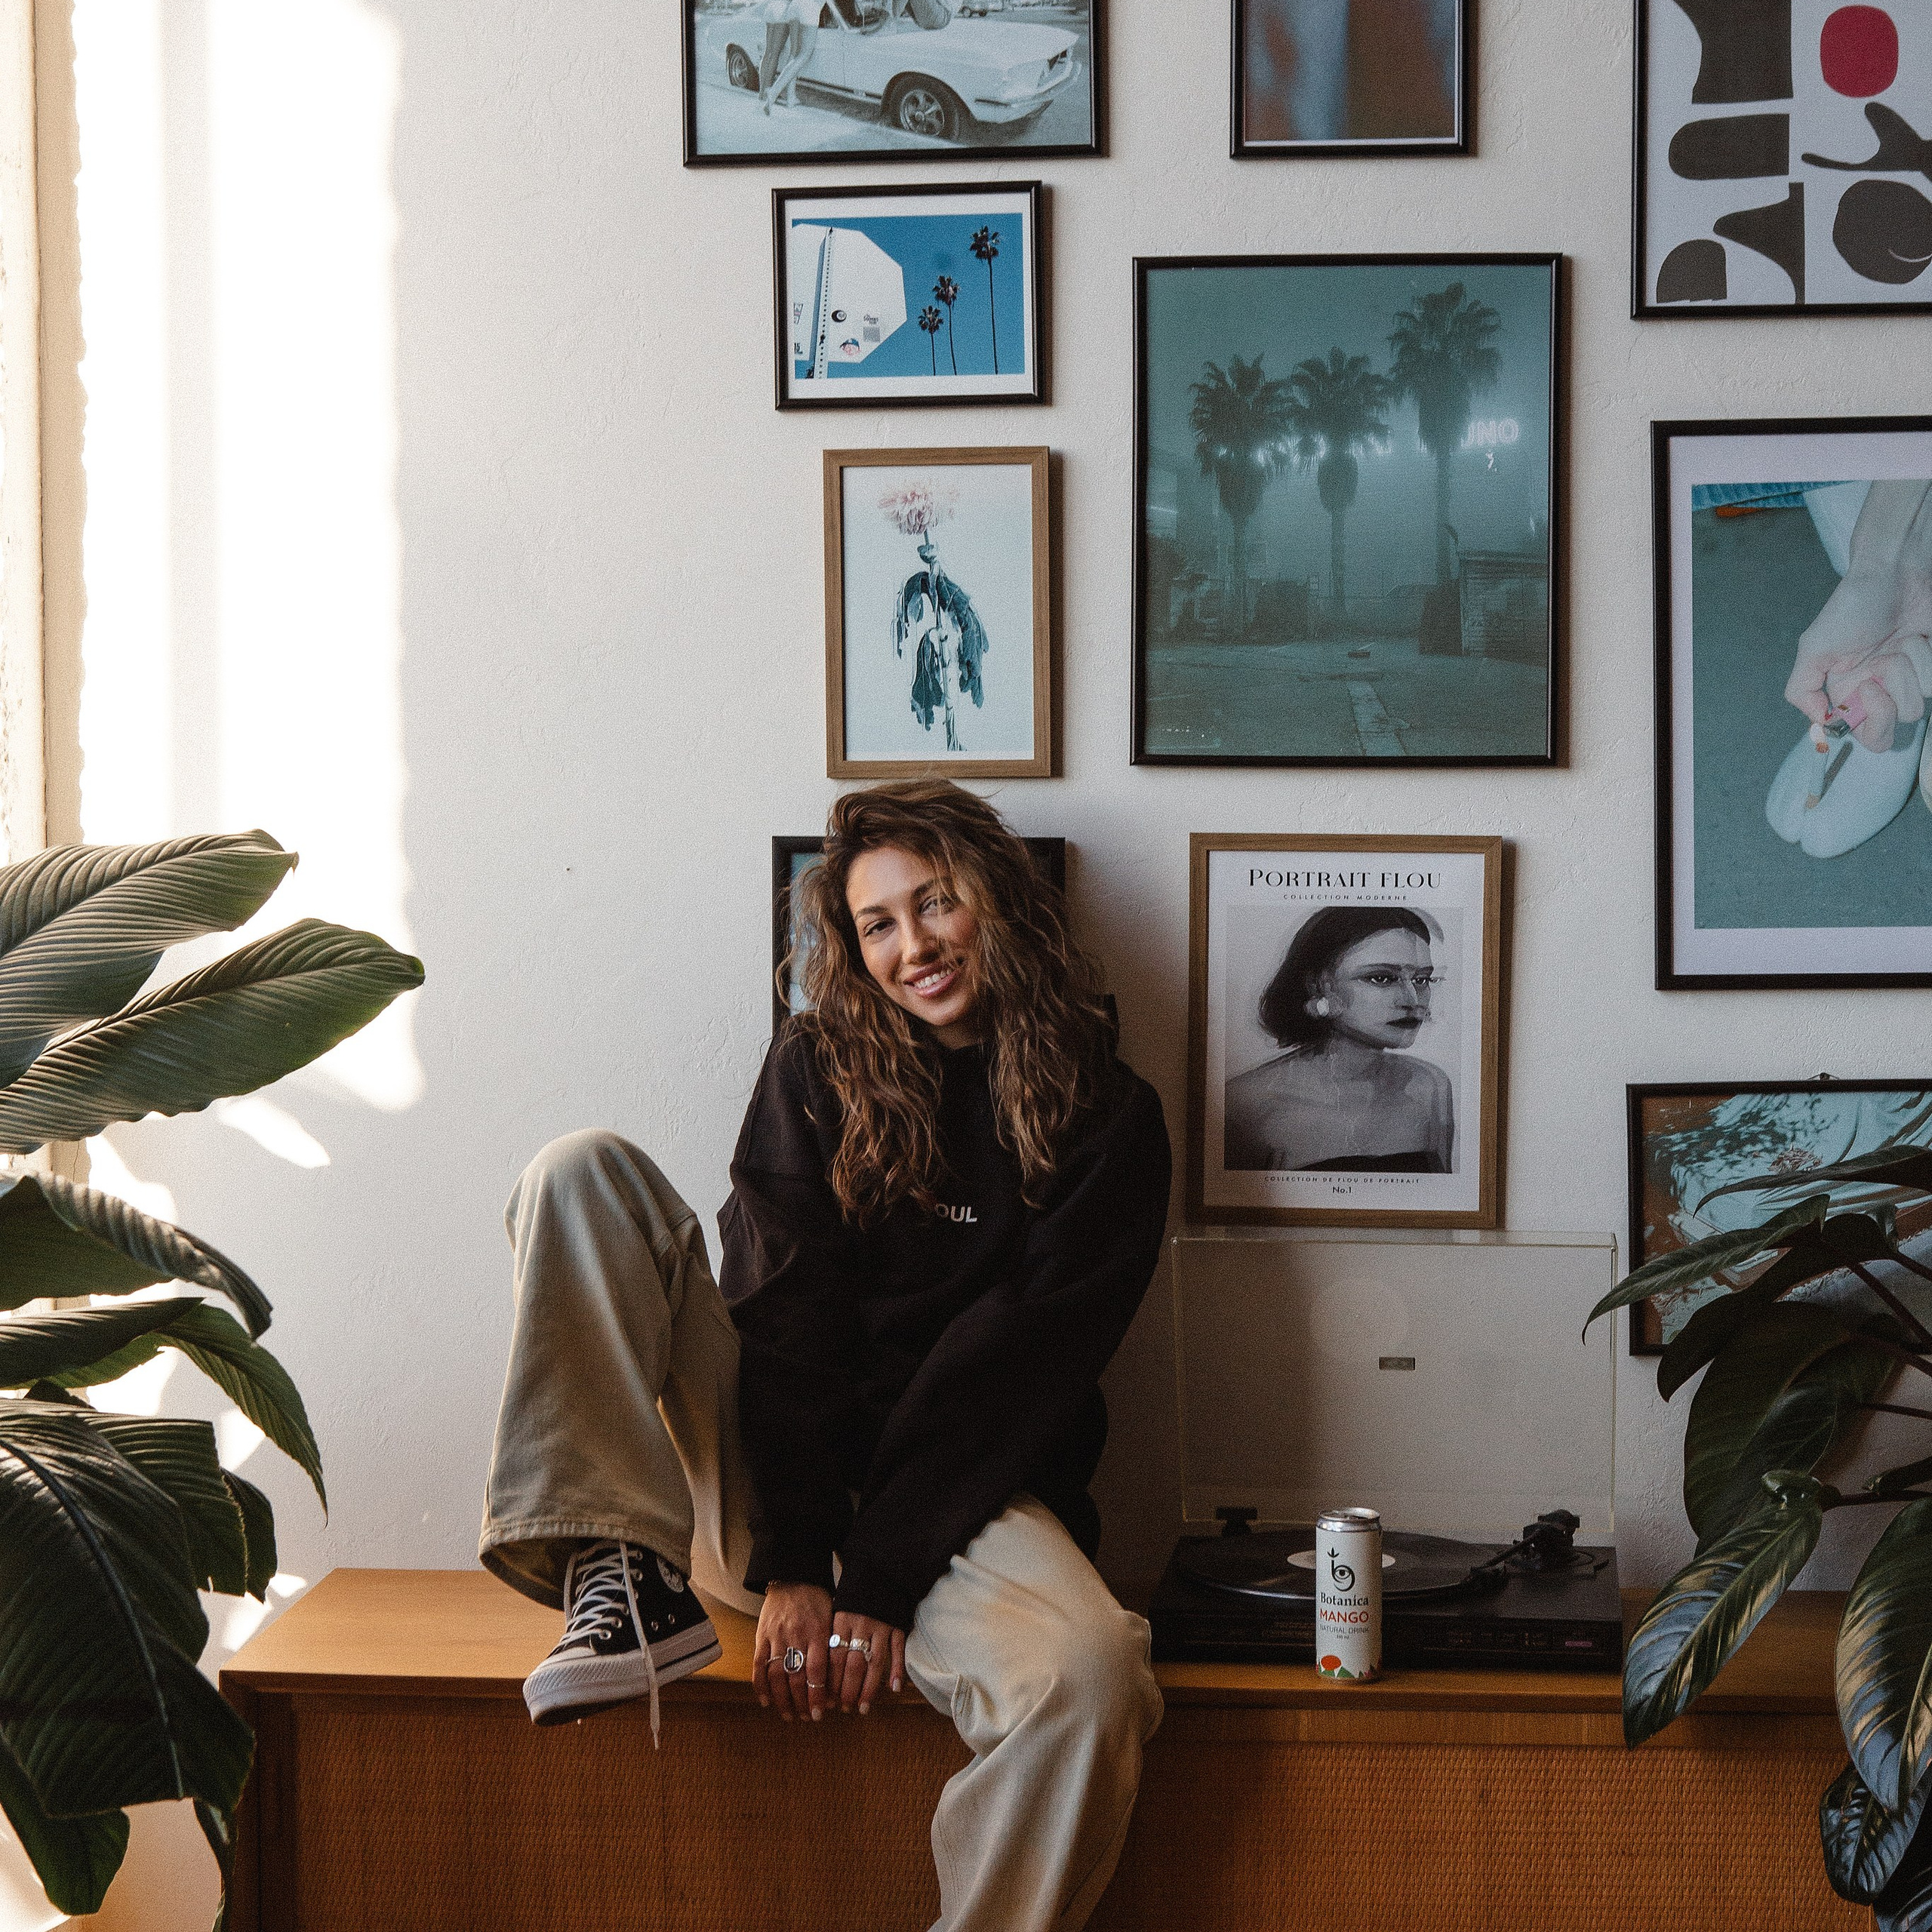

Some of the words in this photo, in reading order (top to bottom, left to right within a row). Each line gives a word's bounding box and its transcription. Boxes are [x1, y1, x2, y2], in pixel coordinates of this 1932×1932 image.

[1249, 869, 1371, 888] PORTRAIT
[1380, 872, 1441, 889] FLOU
[1321, 1592, 1369, 1607] Botanica
[1320, 1608, 1370, 1623] MANGO
[1319, 1624, 1346, 1634] NATURAL
